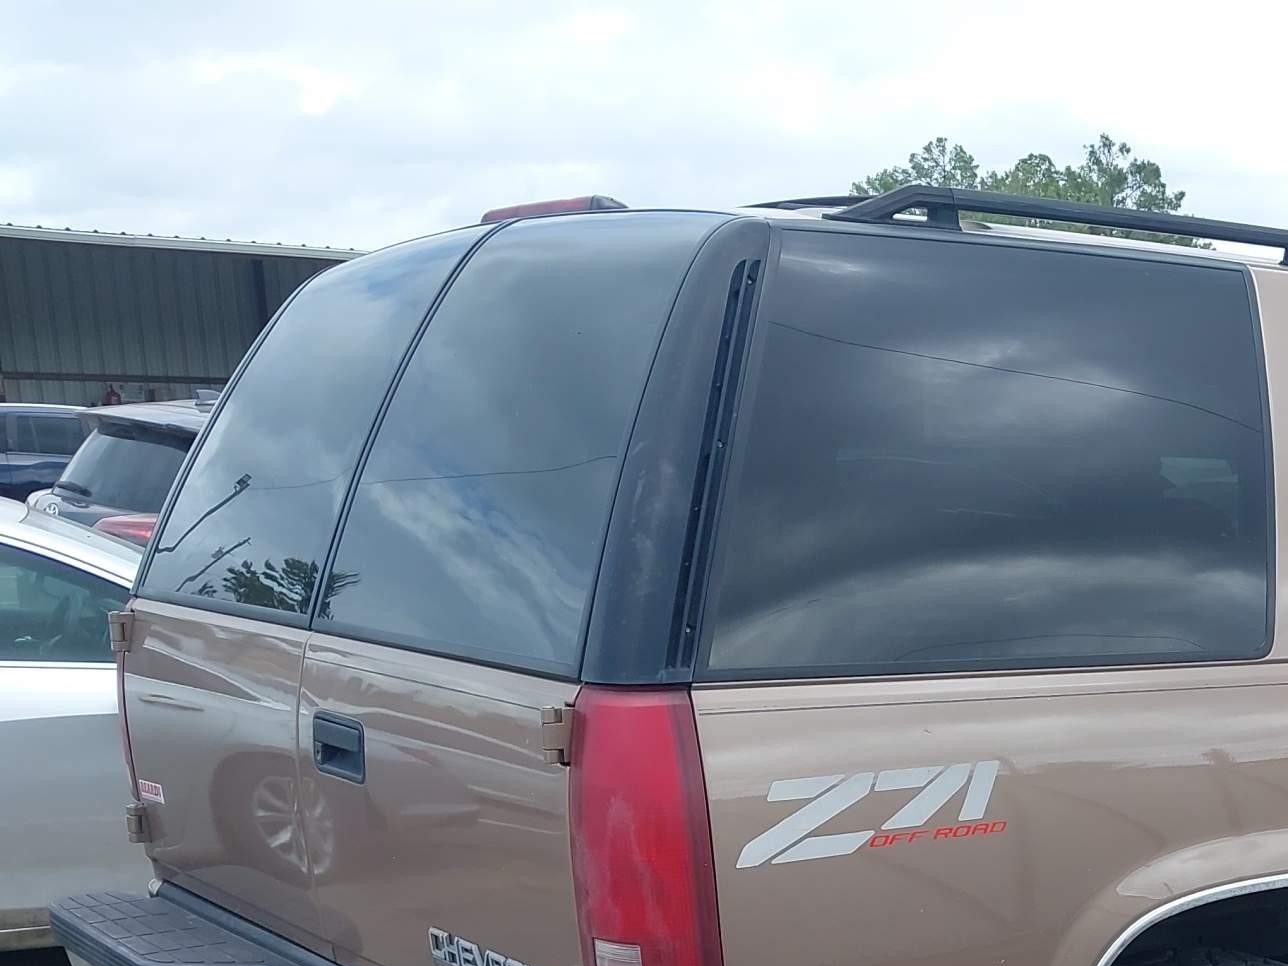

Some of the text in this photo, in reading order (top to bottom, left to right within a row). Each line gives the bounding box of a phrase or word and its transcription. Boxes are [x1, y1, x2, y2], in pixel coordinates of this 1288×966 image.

[736, 759, 1001, 869] Z71
[869, 821, 1008, 848] OFF ROAD
